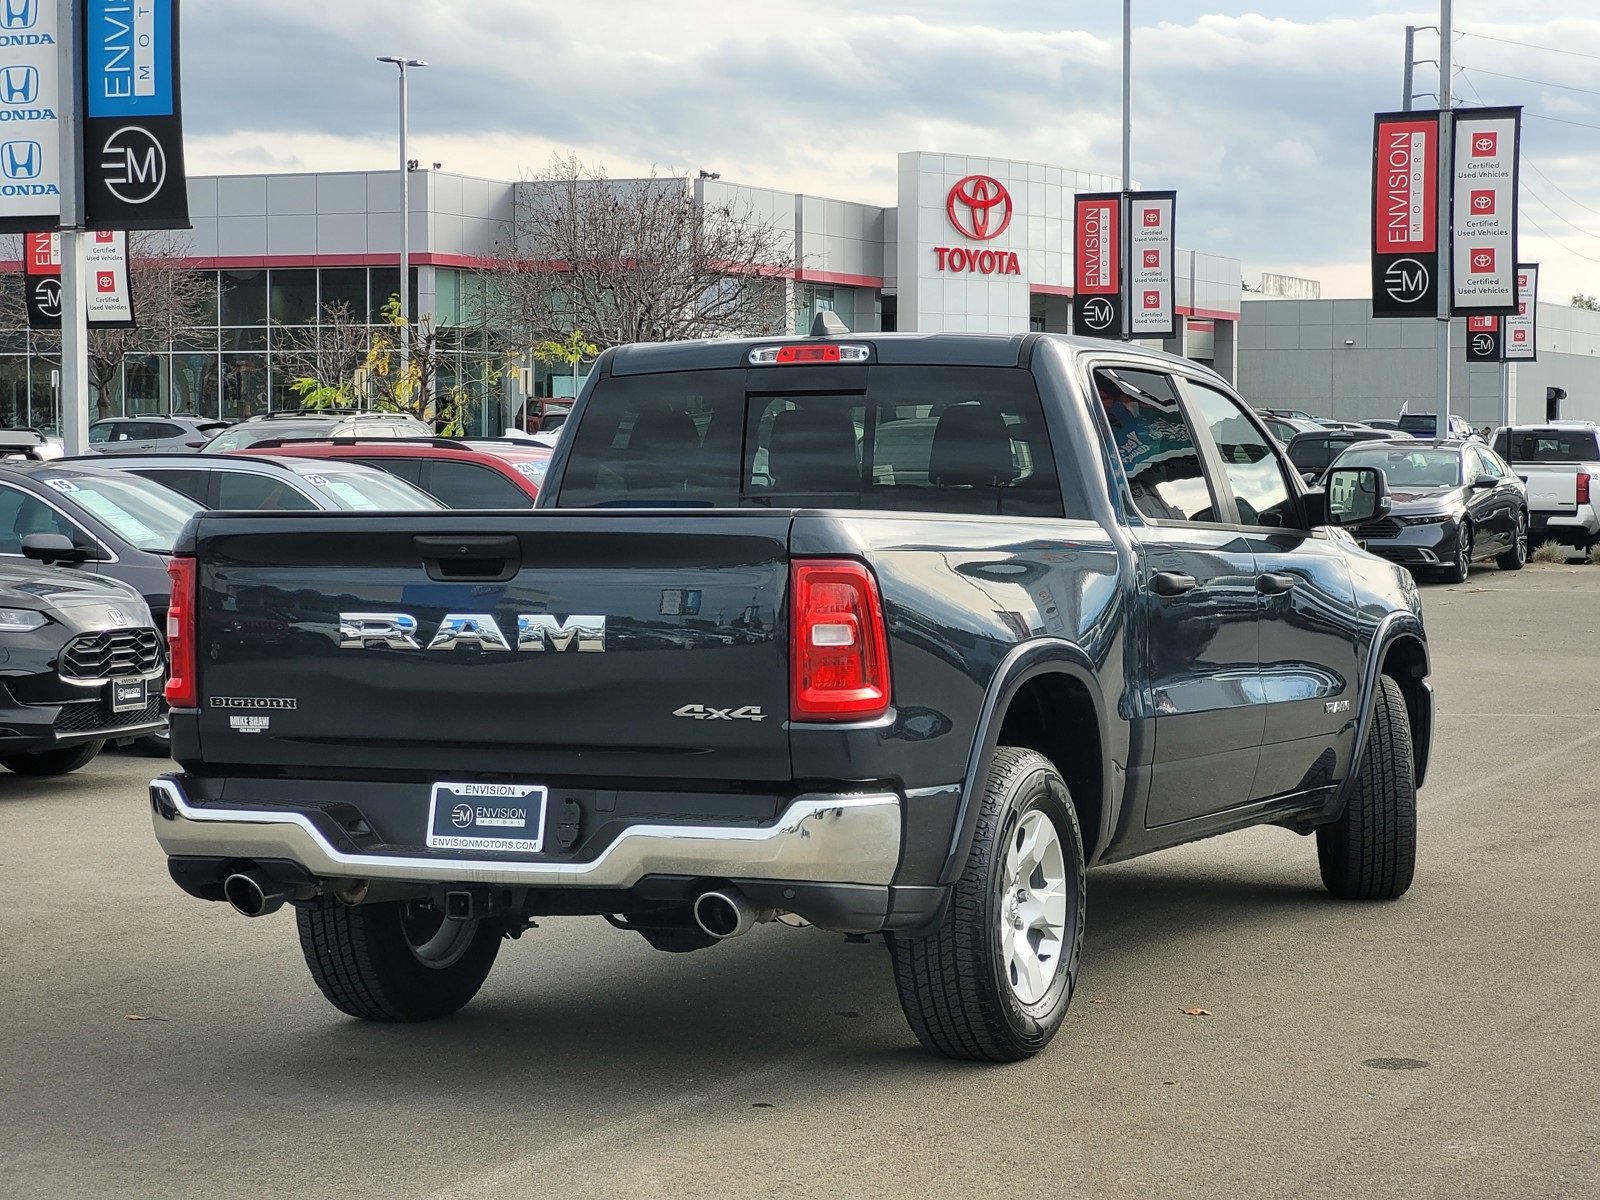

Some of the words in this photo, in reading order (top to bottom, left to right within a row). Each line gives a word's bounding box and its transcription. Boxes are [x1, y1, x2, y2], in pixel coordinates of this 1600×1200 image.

[105, 0, 130, 97] ENVI
[1467, 162, 1500, 170] Certified
[0, 183, 60, 196] ONDA
[1388, 132, 1409, 243] ENVISION
[1412, 142, 1423, 233] MOTORS
[1466, 220, 1499, 228] Certified
[1085, 207, 1099, 287] ENVISION
[934, 247, 1021, 275] TOYOTA
[1467, 278, 1500, 286] Certified
[338, 612, 606, 653] RAM
[210, 696, 298, 709] BIGHORN
[672, 704, 768, 722] 4x4
[230, 716, 249, 726] MIKE
[249, 716, 269, 726] SHAW
[465, 785, 516, 796] ENVISION
[476, 807, 527, 819] ENVISION
[432, 838, 537, 851] ENVISIONMOTORS.COM
